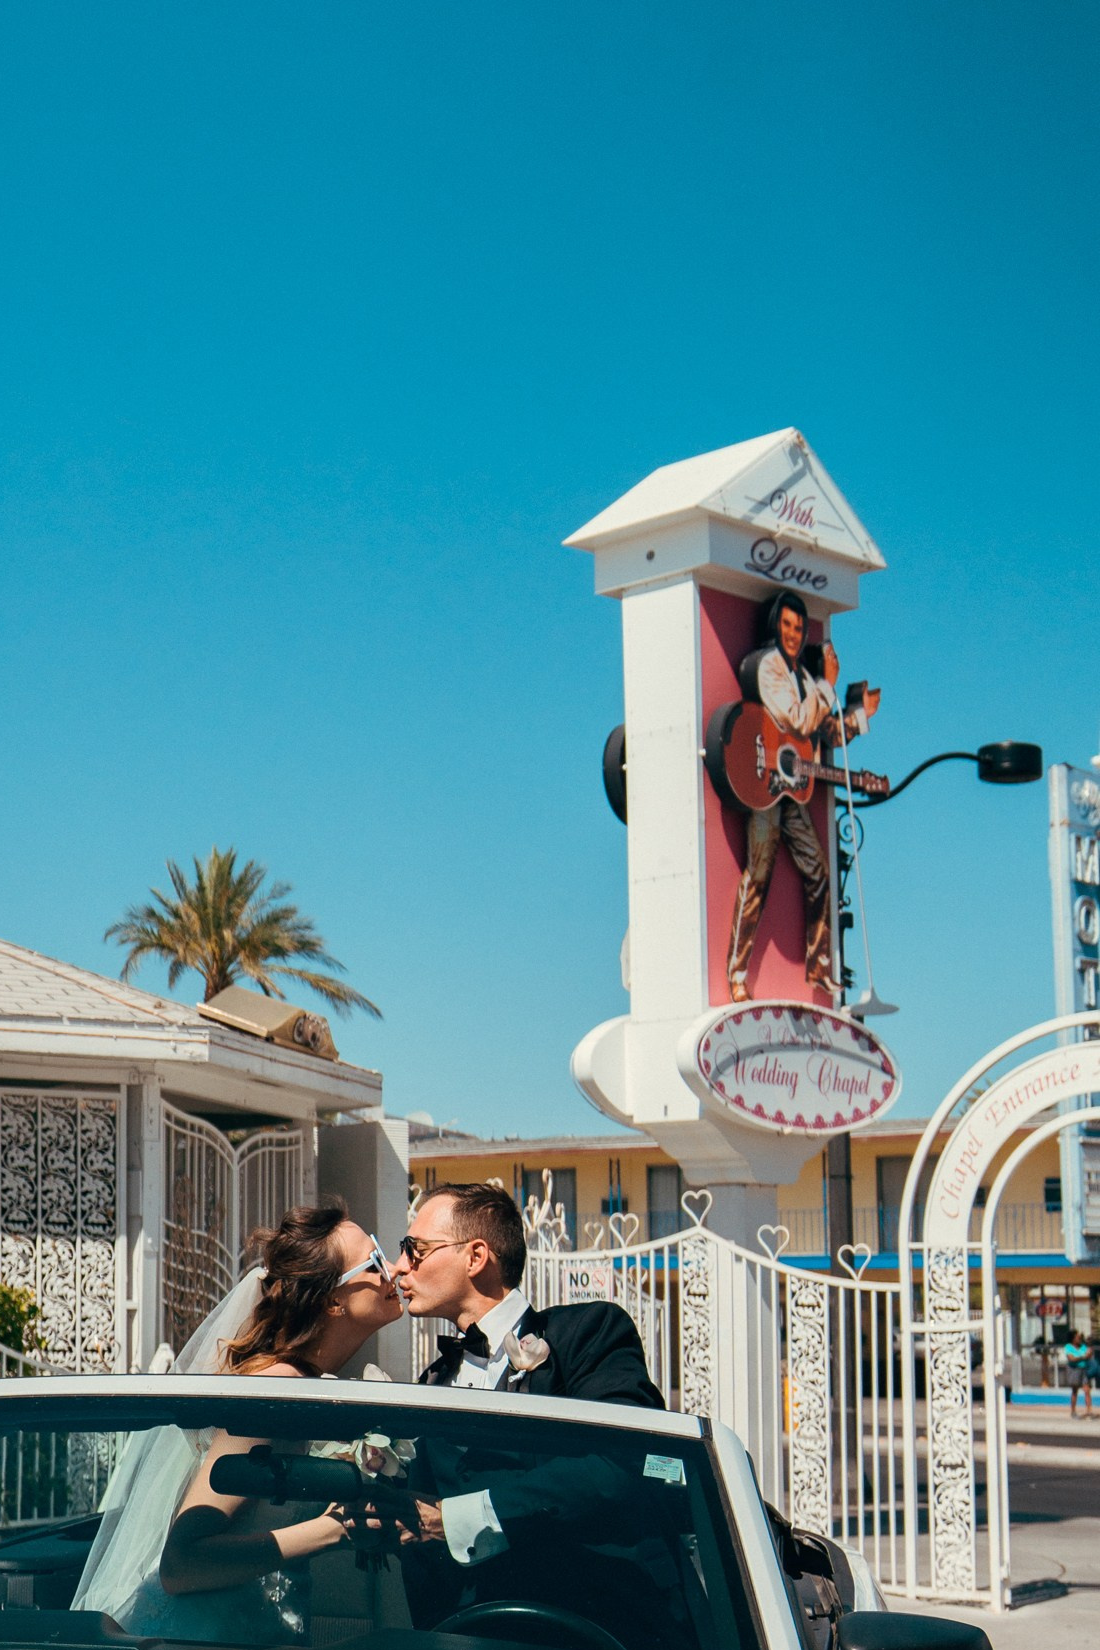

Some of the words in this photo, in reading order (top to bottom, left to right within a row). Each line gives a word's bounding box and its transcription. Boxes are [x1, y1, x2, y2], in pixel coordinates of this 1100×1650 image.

[769, 488, 816, 529] With
[744, 537, 829, 591] Love
[715, 1042, 799, 1099] Wedding
[806, 1052, 872, 1105] Chapel
[939, 1124, 983, 1220] Chapel
[985, 1063, 1081, 1128] Entrance
[569, 1272, 590, 1288] NO
[569, 1290, 606, 1300] SMOKING
